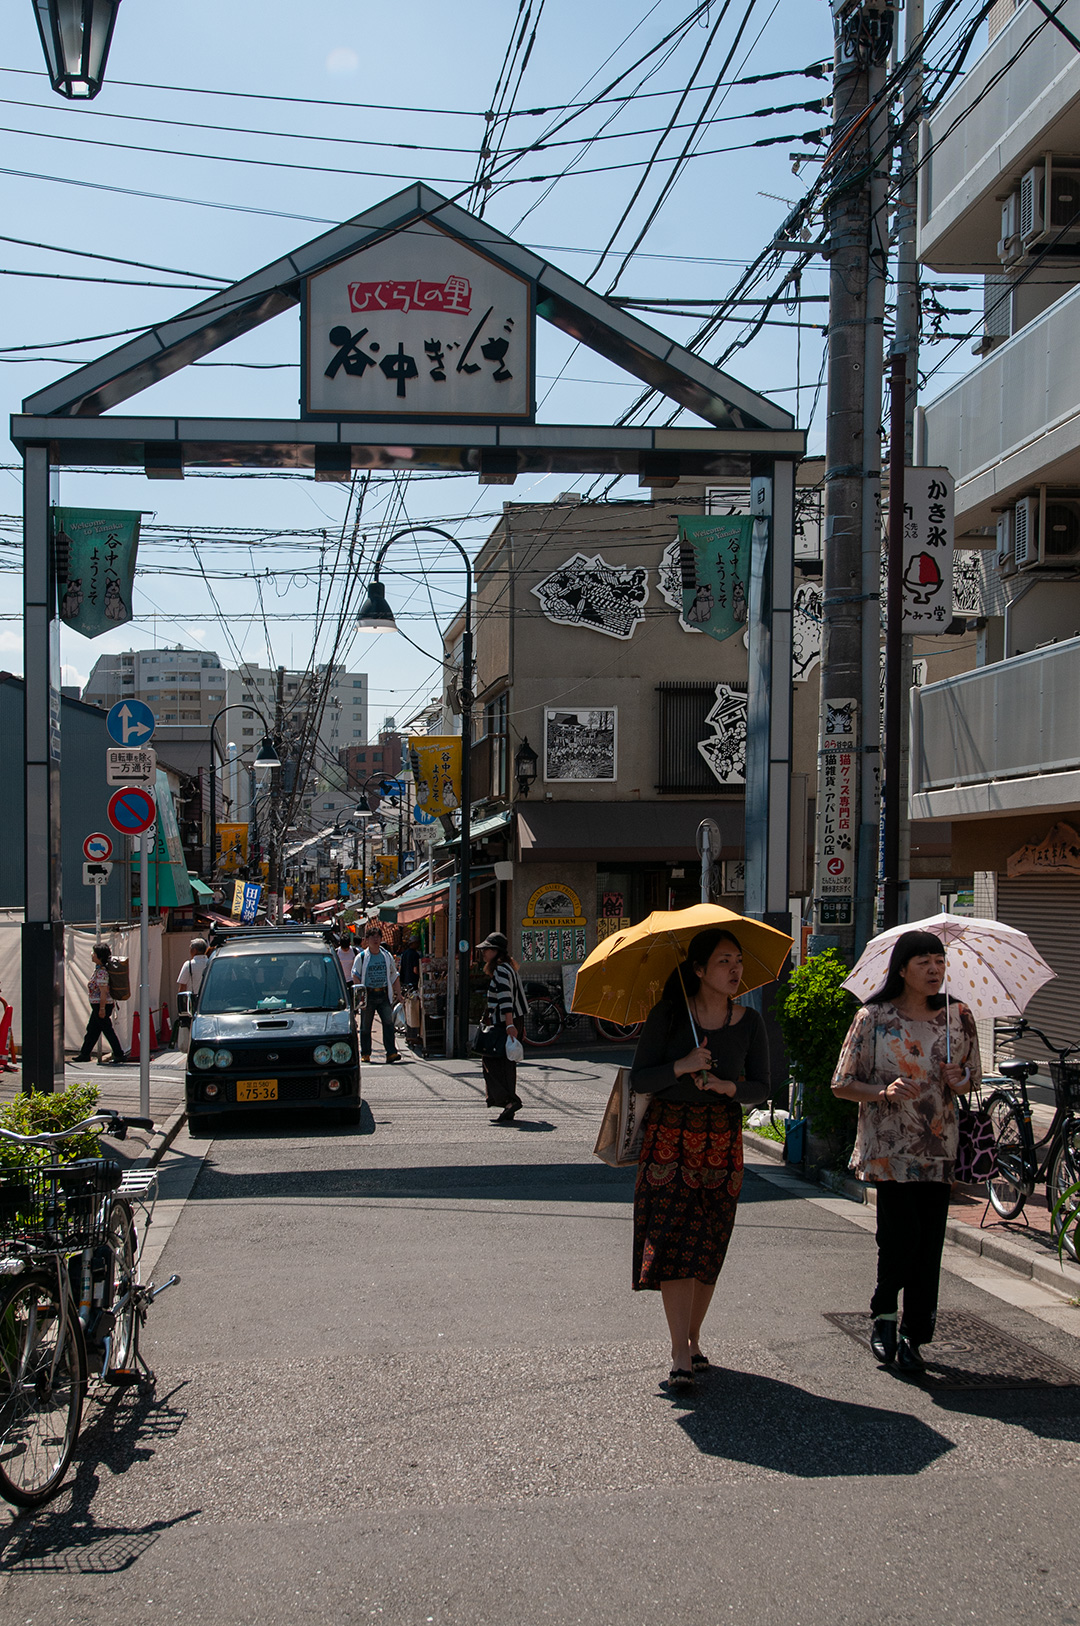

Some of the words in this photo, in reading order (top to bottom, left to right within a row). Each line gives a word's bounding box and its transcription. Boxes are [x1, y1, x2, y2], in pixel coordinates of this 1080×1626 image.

[350, 276, 472, 314] ひぐらしの里
[324, 305, 515, 399] 谷中ぎんざ
[69, 519, 106, 531] Welcome
[692, 525, 726, 538] Welcome
[926, 479, 948, 548] かき氷
[104, 533, 123, 577] 谷中へ
[727, 537, 741, 580] 谷中へ
[88, 547, 101, 606] ようこそ
[716, 552, 728, 609] ようこそ
[110, 752, 152, 763] 自転車を除く
[110, 763, 152, 773] 一方通行
[441, 752, 452, 780] 谷中へ
[432, 764, 440, 802] ようこそ
[839, 753, 851, 830] 猫グッズ専門店
[823, 754, 837, 856] 猫雑貨・アパレルの店
[246, 1088, 276, 1100] 75-36
